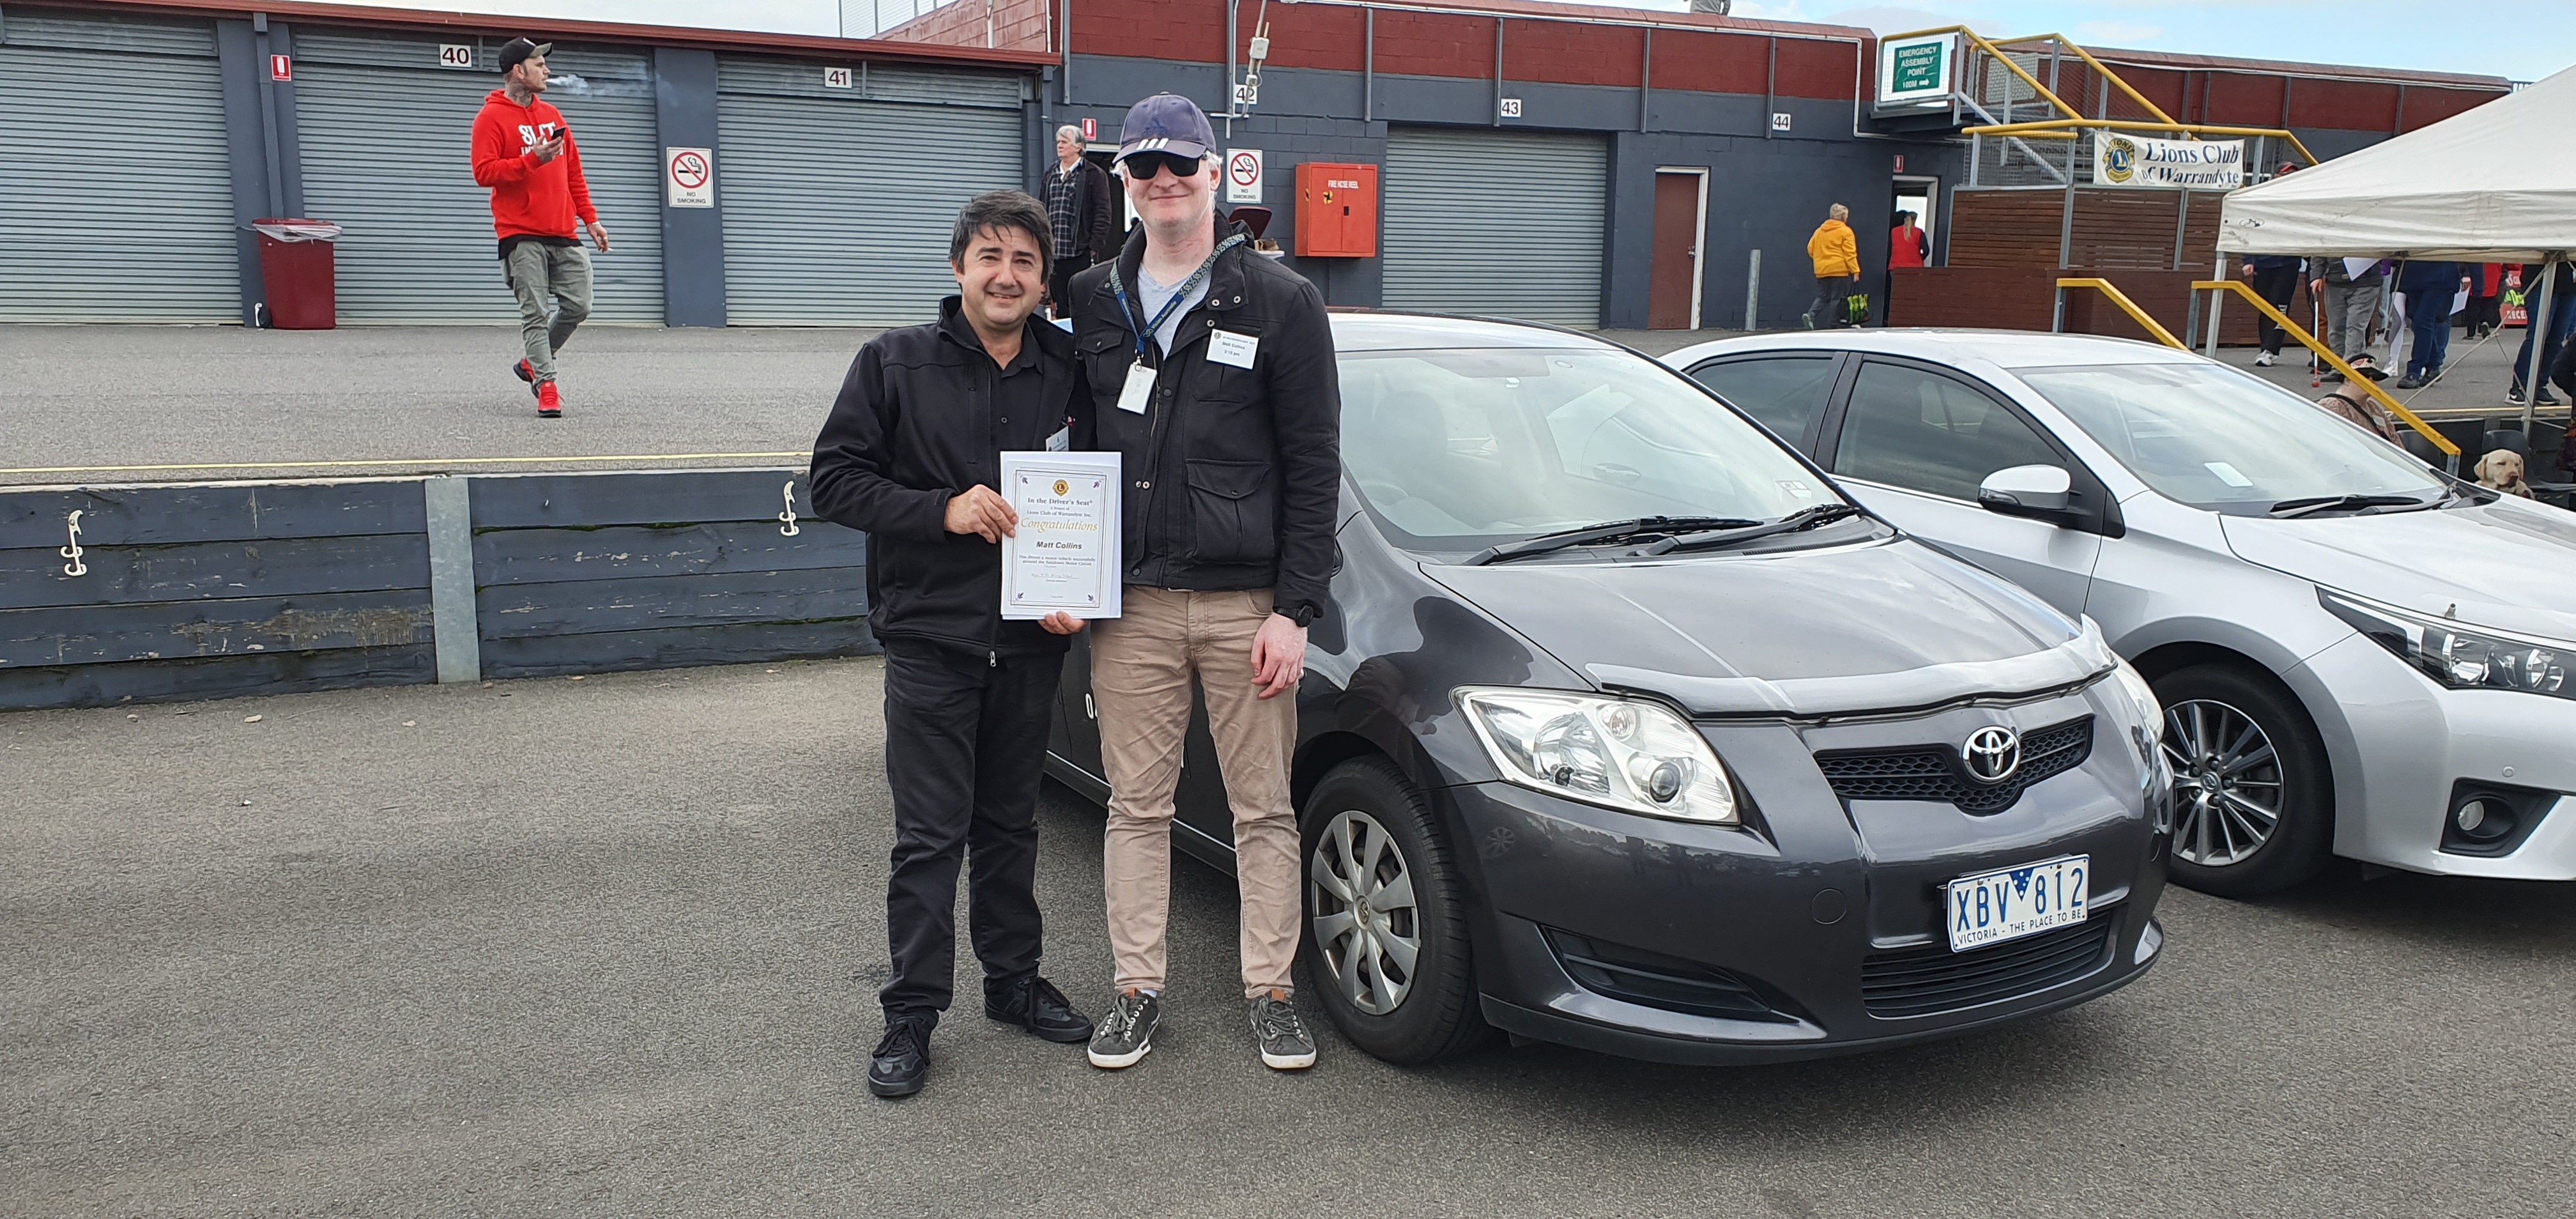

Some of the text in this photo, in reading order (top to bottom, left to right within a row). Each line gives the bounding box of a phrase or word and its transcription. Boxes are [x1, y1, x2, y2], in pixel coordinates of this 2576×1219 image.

[442, 47, 469, 64] 40
[1899, 45, 1937, 58] EMERGENCY
[1901, 56, 1934, 68] ASSEMBLY
[829, 70, 847, 86] 41
[1907, 67, 1927, 77] POINT
[1903, 80, 1917, 88] 100M
[1236, 88, 1254, 102] 42
[1502, 102, 1519, 114] 43
[1774, 116, 1788, 128] 44
[2110, 139, 2133, 150] LIONS
[2143, 142, 2239, 164] Lions Club
[2141, 166, 2239, 187] of Warrandyte
[1151, 318, 1163, 329] Vision
[1021, 518, 1098, 533] Congratulations
[1956, 868, 2083, 932] XBV 812
[1958, 931, 1997, 944] VICTORIA
[2010, 921, 2025, 933] THE
[2030, 915, 2053, 930] PLACE
[2057, 912, 2067, 923] TO
